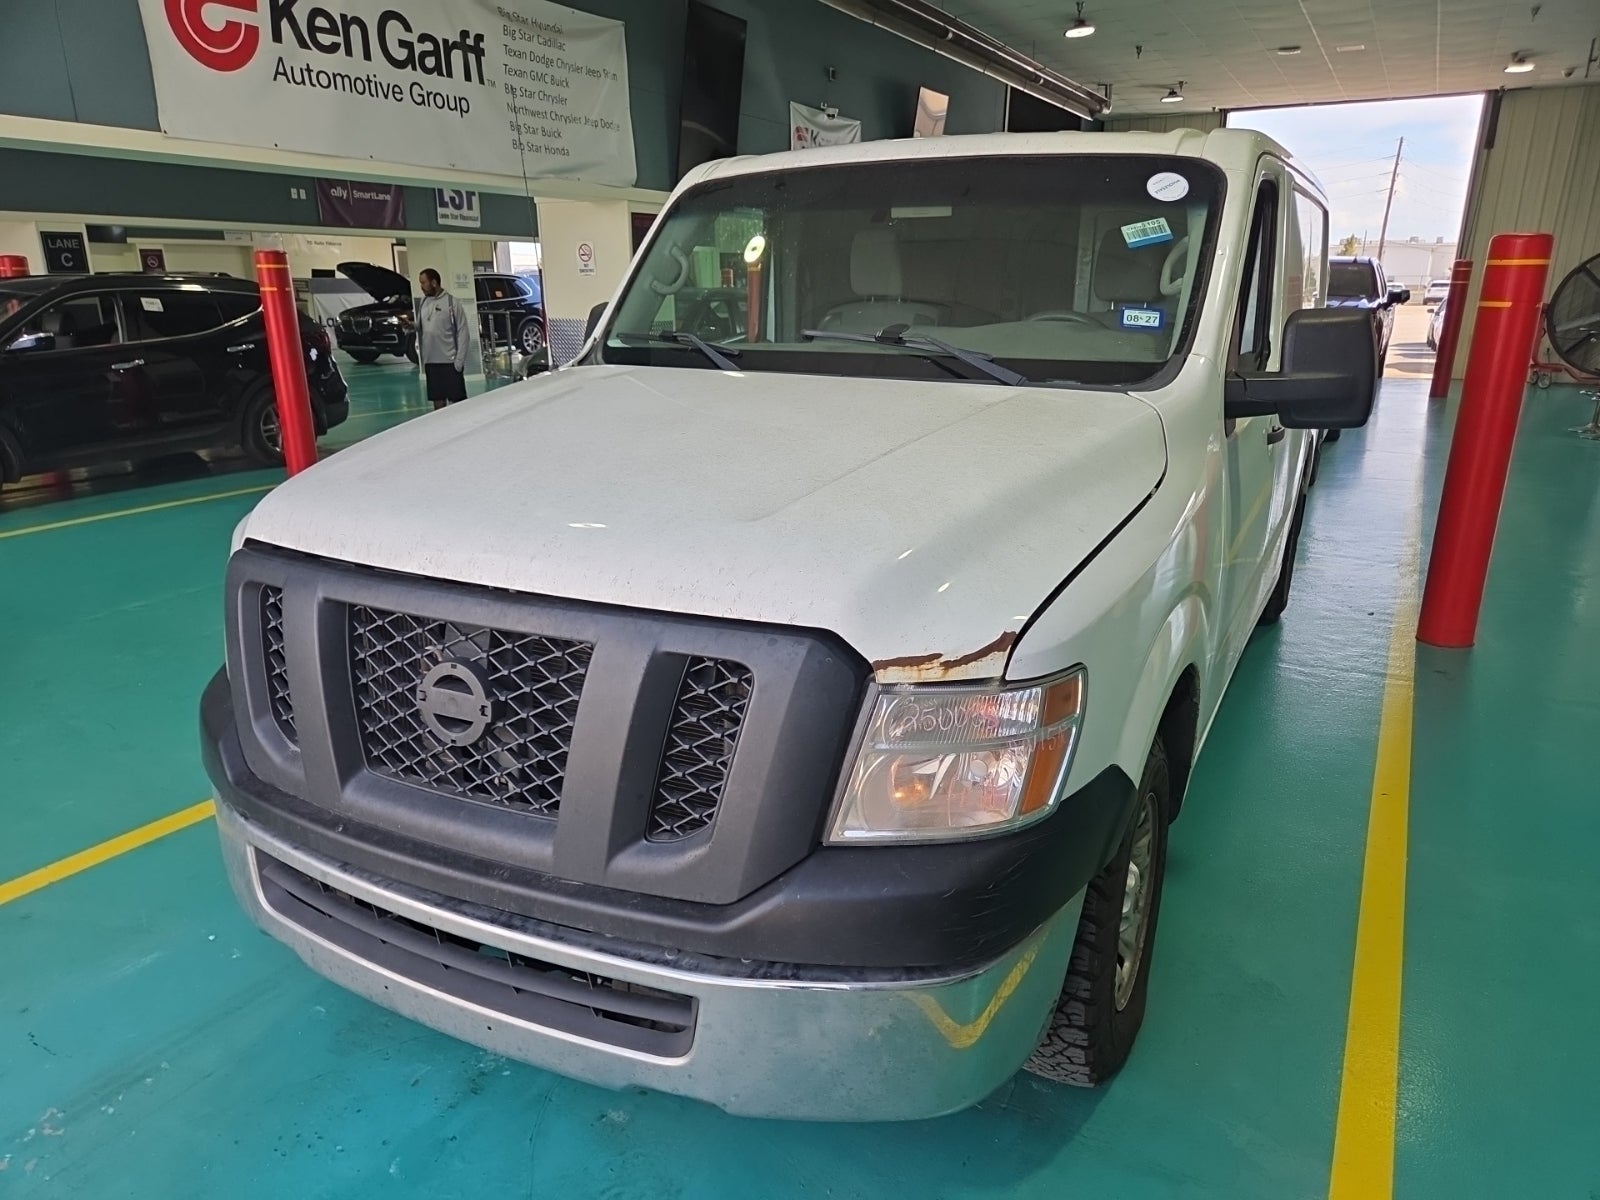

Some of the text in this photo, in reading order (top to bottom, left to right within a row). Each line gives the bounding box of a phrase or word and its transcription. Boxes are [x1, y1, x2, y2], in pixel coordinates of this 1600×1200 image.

[511, 11, 528, 24] Star
[531, 18, 564, 34] Hyundai
[269, 0, 372, 62] Ken
[377, 9, 485, 86] Garff
[502, 24, 566, 52] Big Star Cadillac
[503, 44, 527, 60] Texan
[529, 50, 555, 69] Dodge
[556, 58, 583, 75] Chrysler
[273, 56, 470, 118] Automotive Group
[503, 63, 569, 88] Texan GMC Buick
[504, 83, 568, 106] Big Star Chrysler
[507, 102, 548, 120] Northwest
[550, 110, 582, 126] Chrysler
[509, 121, 562, 139] Big Star Buick
[526, 141, 542, 153] Star
[544, 143, 570, 157] Honda
[330, 186, 347, 200] ally
[48, 239, 80, 249] LANE
[61, 253, 74, 267] C
